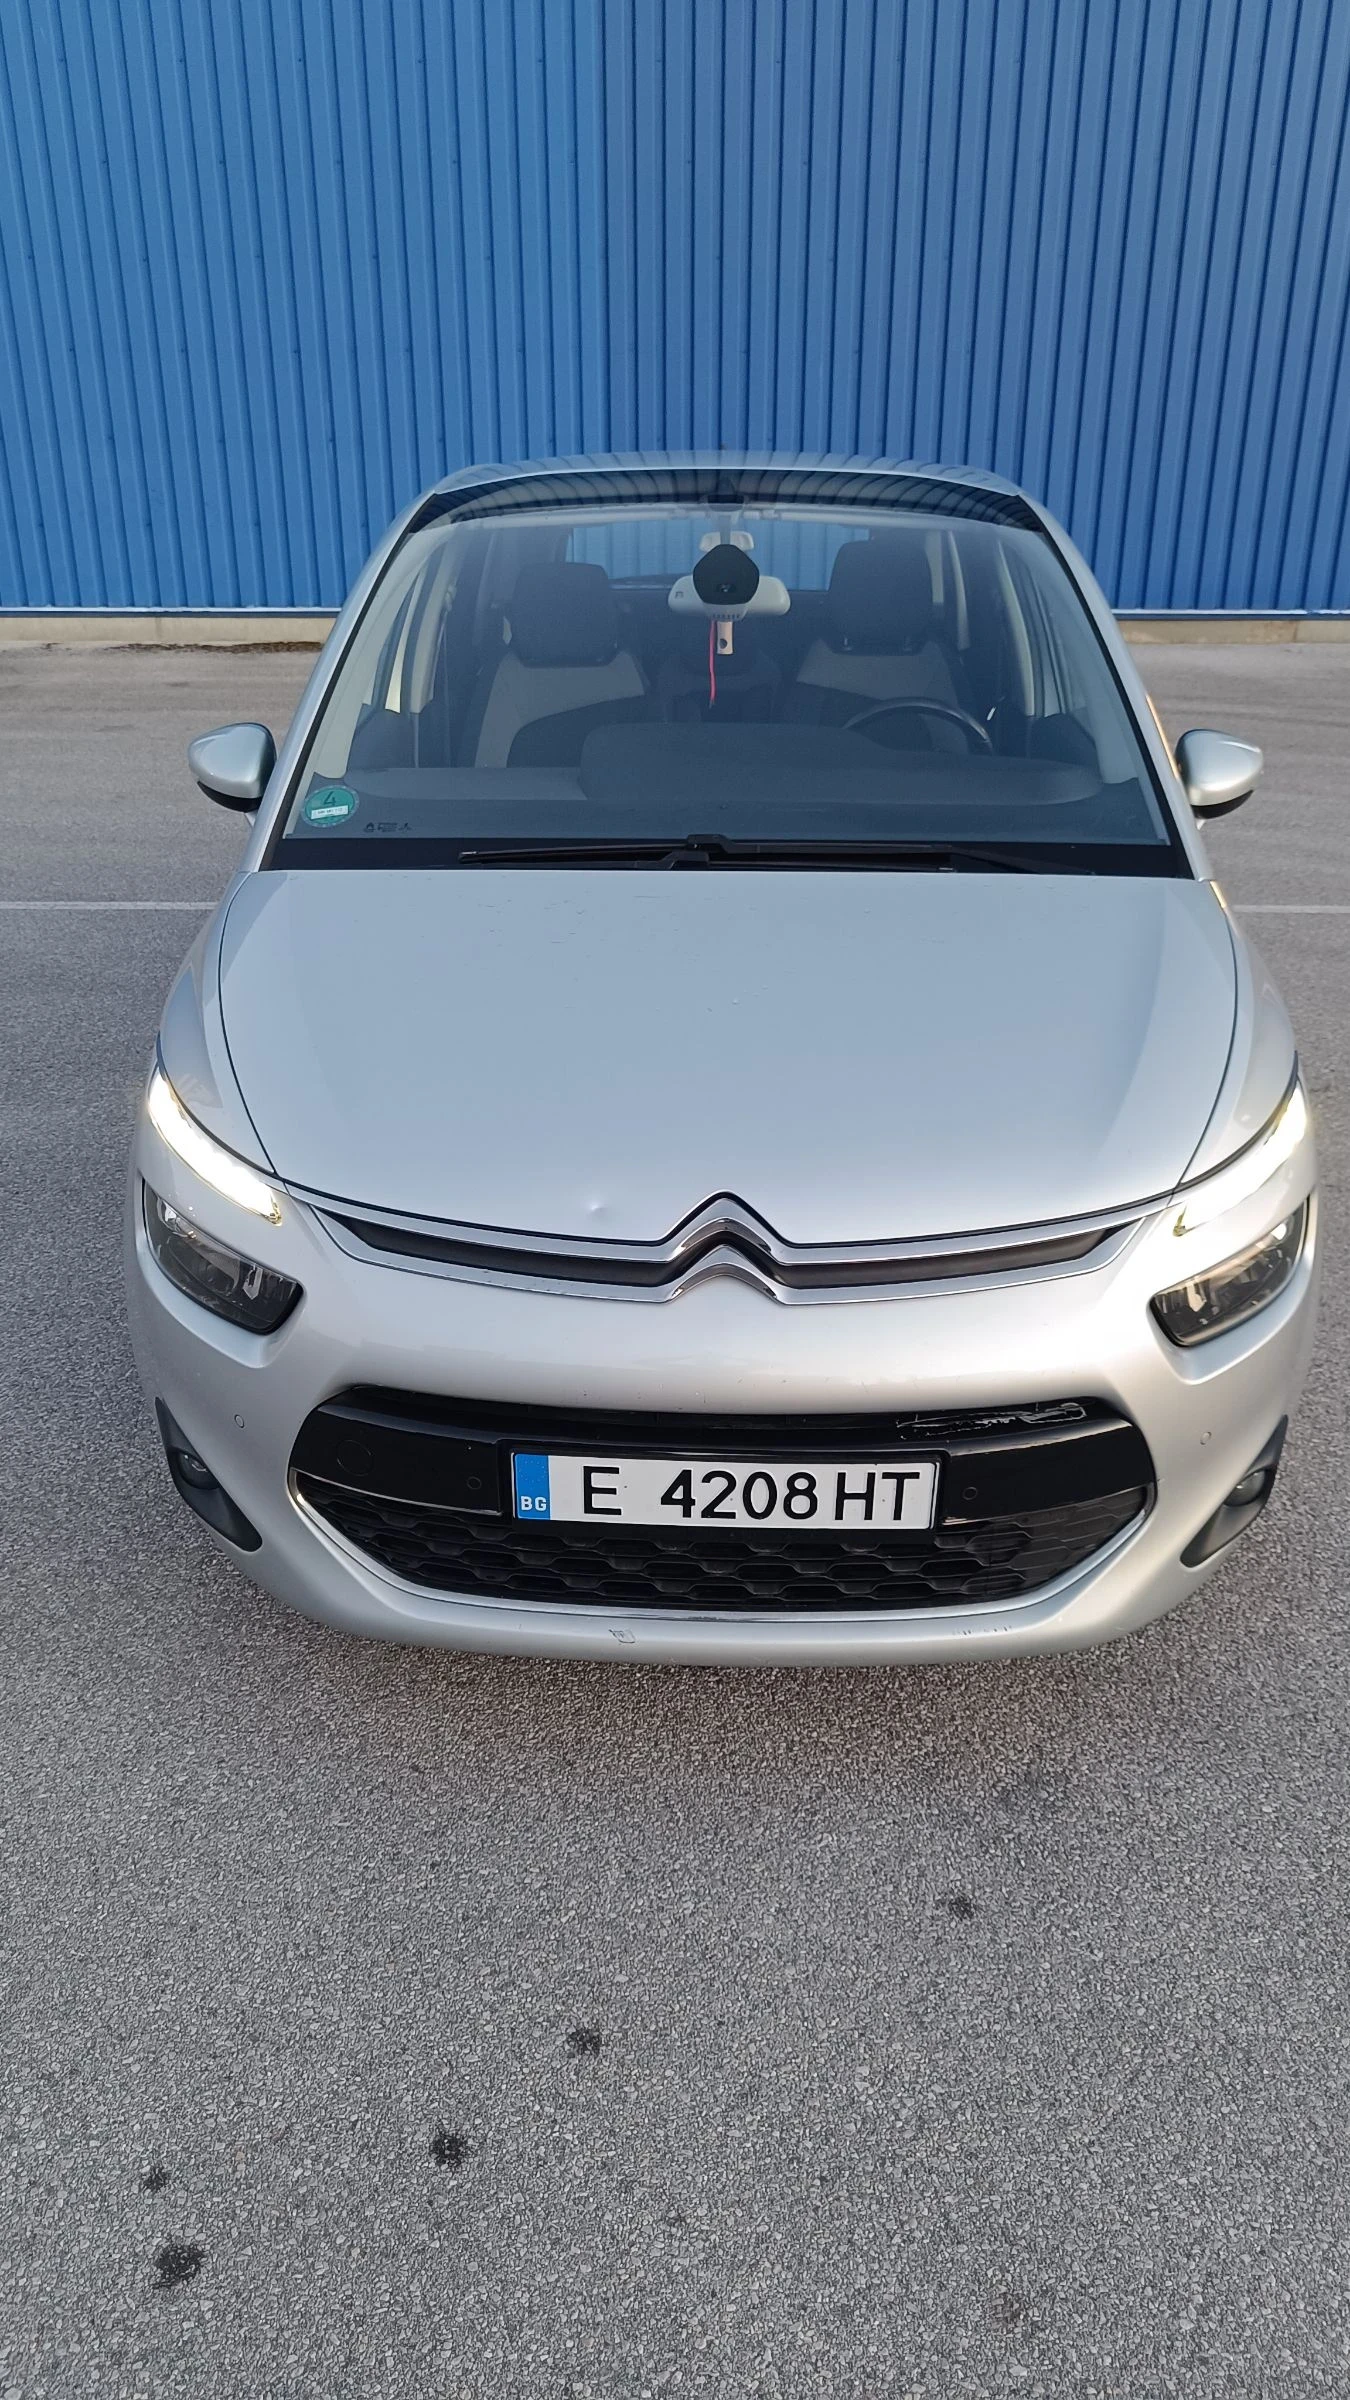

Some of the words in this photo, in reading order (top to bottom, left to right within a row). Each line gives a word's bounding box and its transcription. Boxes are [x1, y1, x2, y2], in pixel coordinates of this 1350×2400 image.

[324, 791, 336, 806] 4
[582, 1465, 622, 1516] E
[660, 1469, 818, 1520] 4208
[834, 1471, 921, 1521] HT
[520, 1495, 547, 1512] BG
